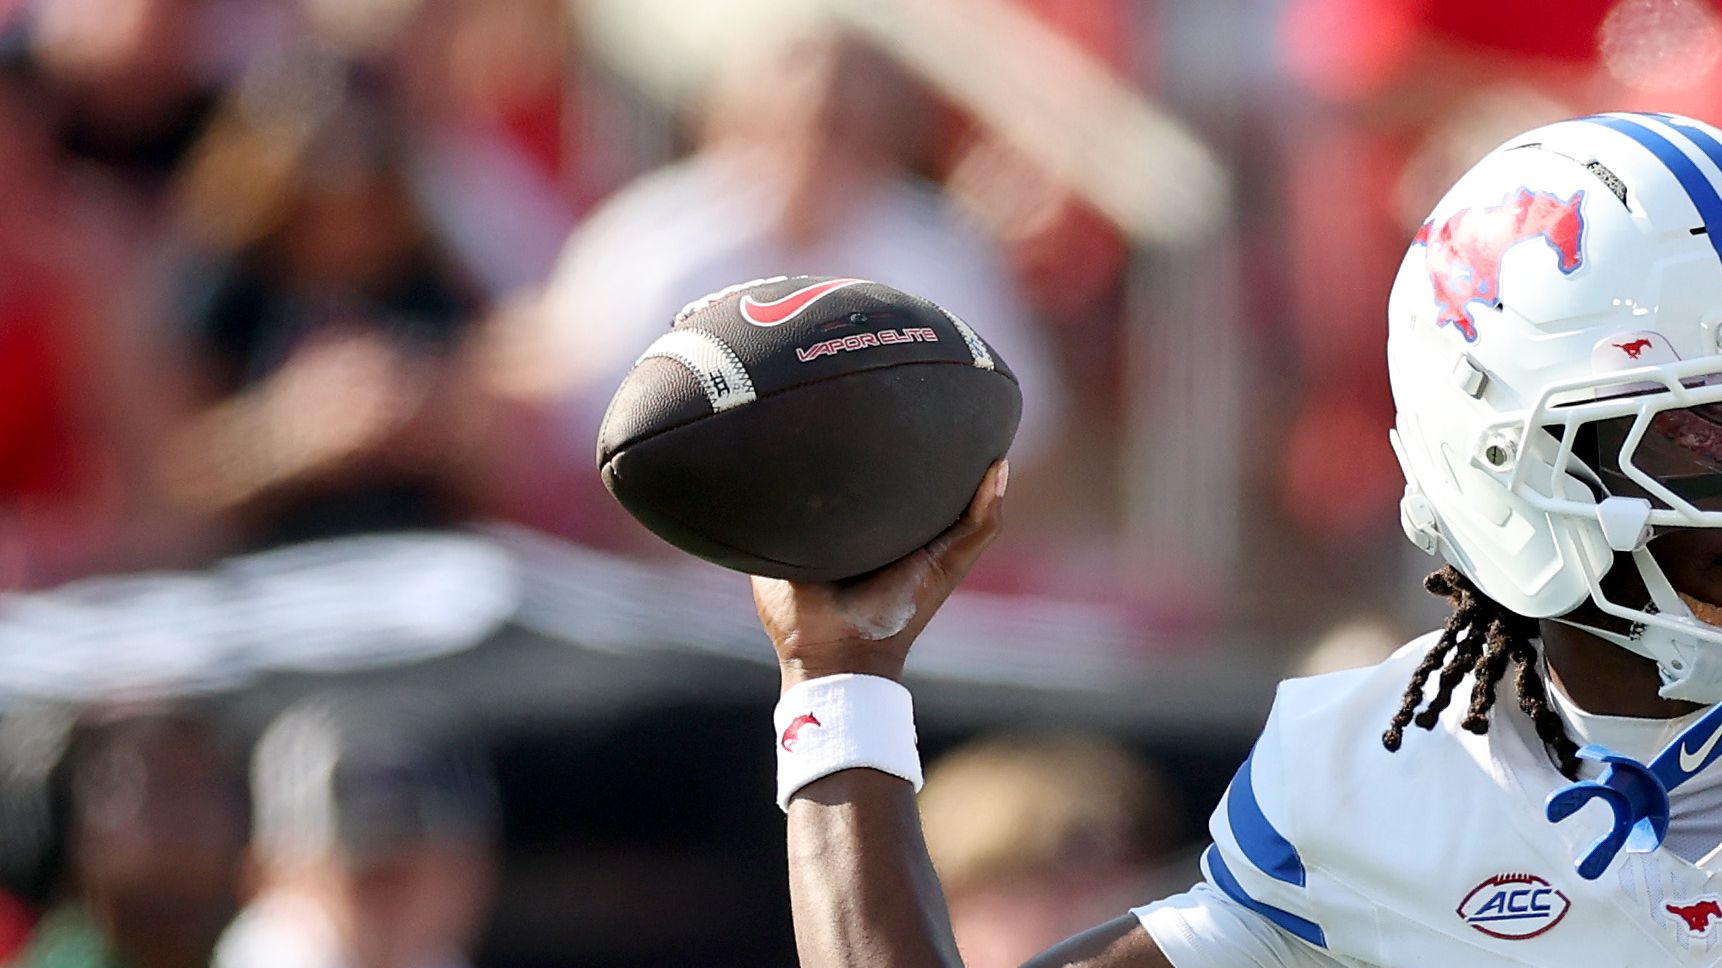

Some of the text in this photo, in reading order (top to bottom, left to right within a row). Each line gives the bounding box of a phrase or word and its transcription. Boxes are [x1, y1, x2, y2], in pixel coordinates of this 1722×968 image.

[796, 327, 938, 362] VAPOR ELITE
[1474, 888, 1553, 916] ACC
